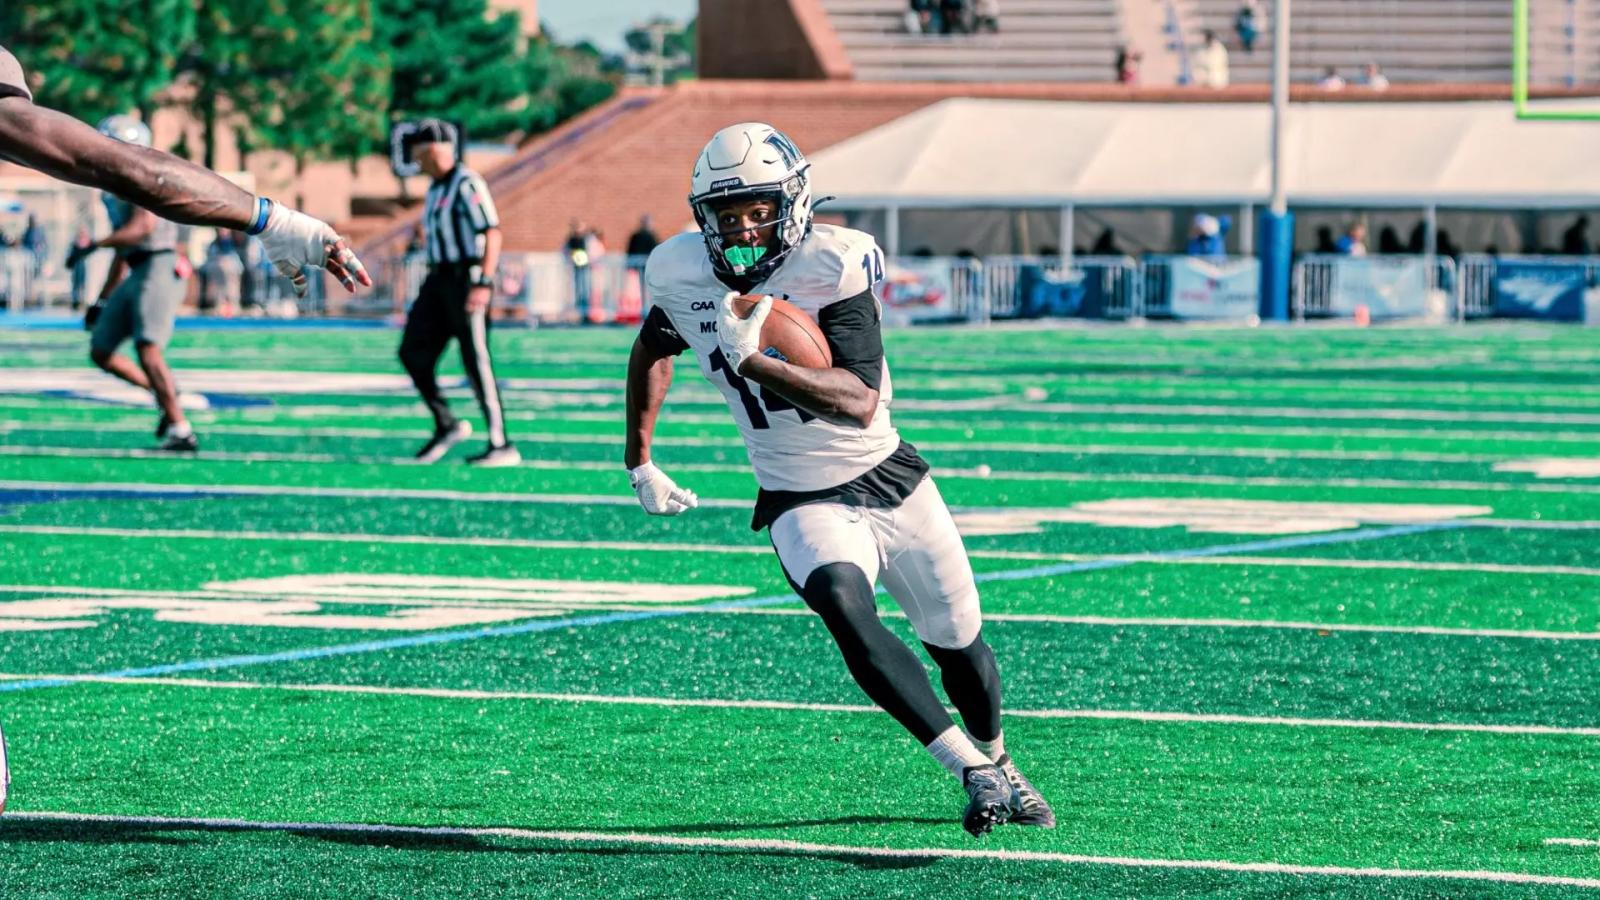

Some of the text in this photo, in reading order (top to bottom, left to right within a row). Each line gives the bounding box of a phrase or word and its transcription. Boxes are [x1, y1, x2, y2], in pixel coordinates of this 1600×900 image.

[712, 179, 739, 189] HAWKS
[862, 248, 883, 288] 14
[691, 301, 716, 311] CAA
